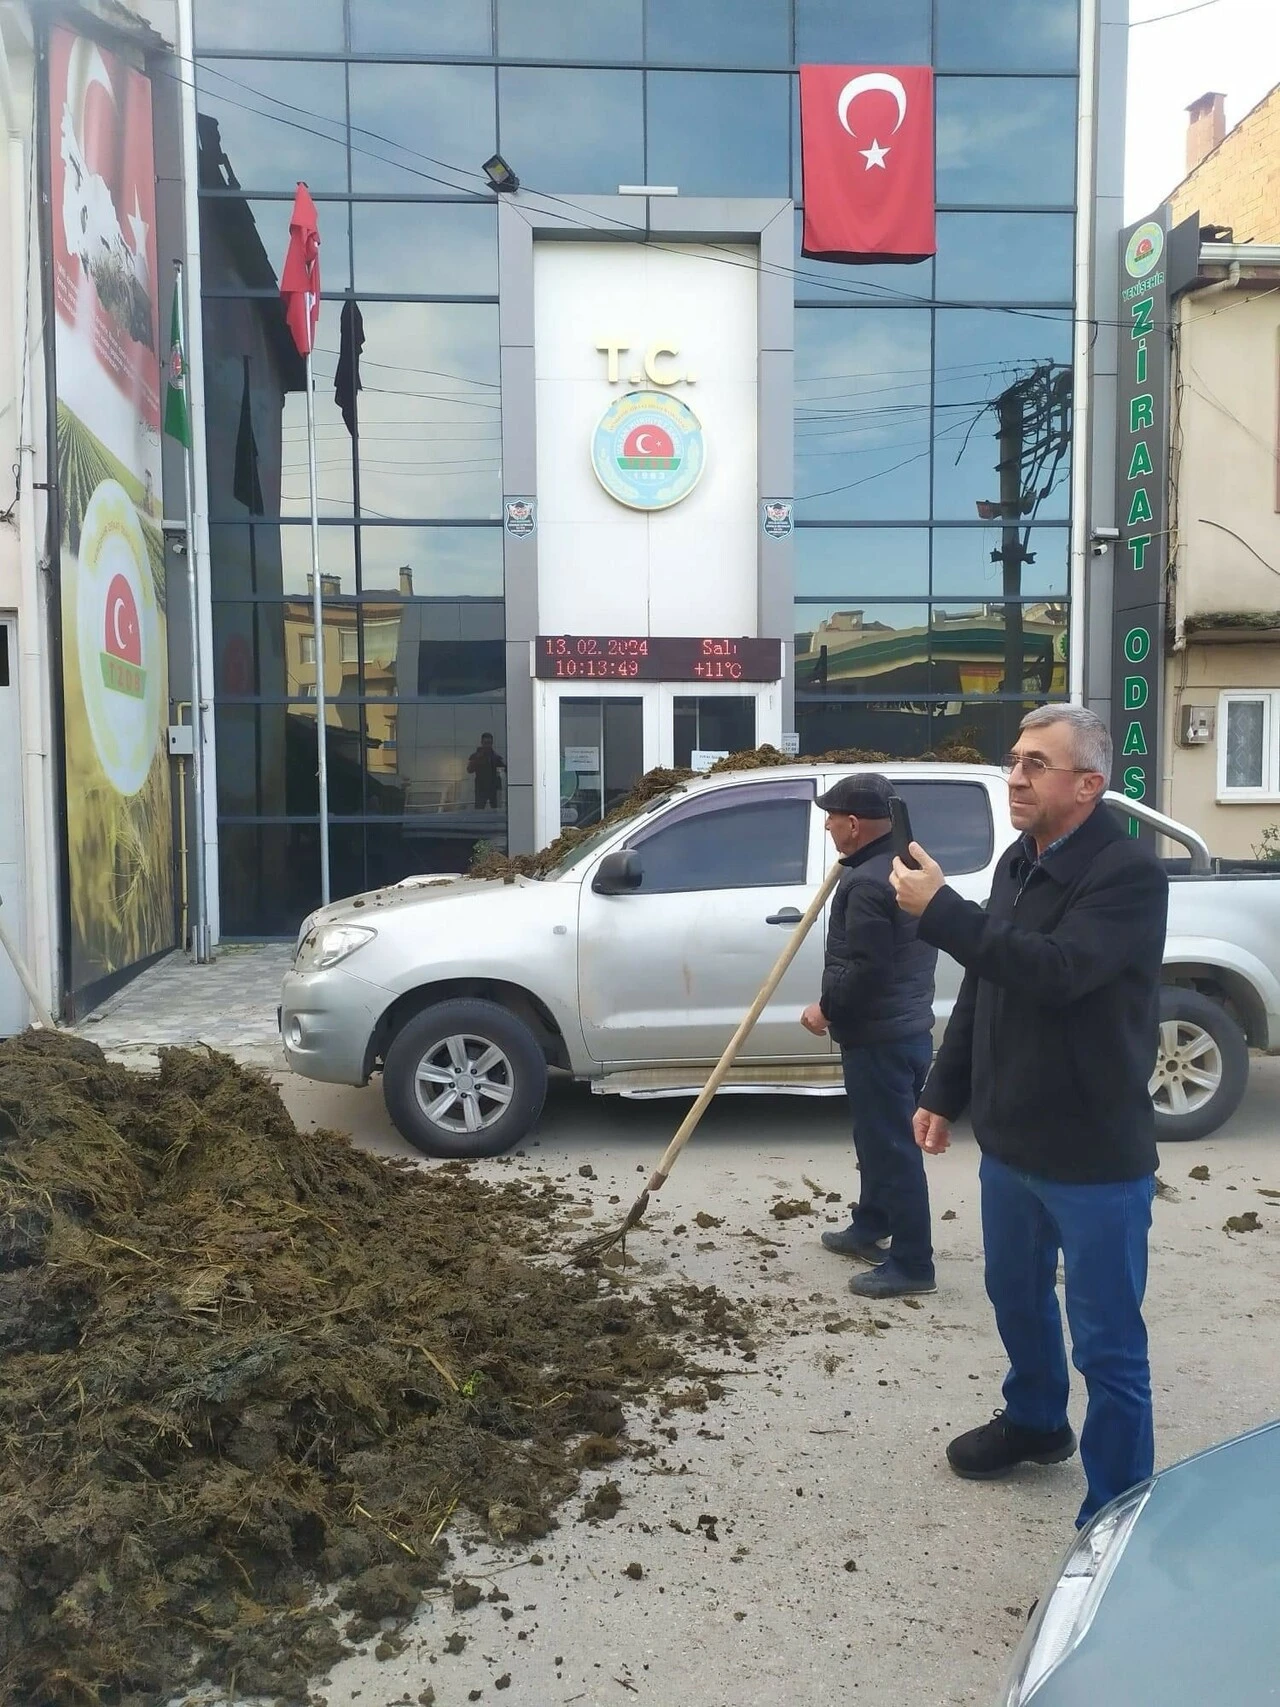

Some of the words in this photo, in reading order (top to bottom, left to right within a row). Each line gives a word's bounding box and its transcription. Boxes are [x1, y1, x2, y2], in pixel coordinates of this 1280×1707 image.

[595, 338, 697, 386] T.C.
[1127, 296, 1154, 571] ZİRAAT
[556, 659, 638, 676] 10:13:49
